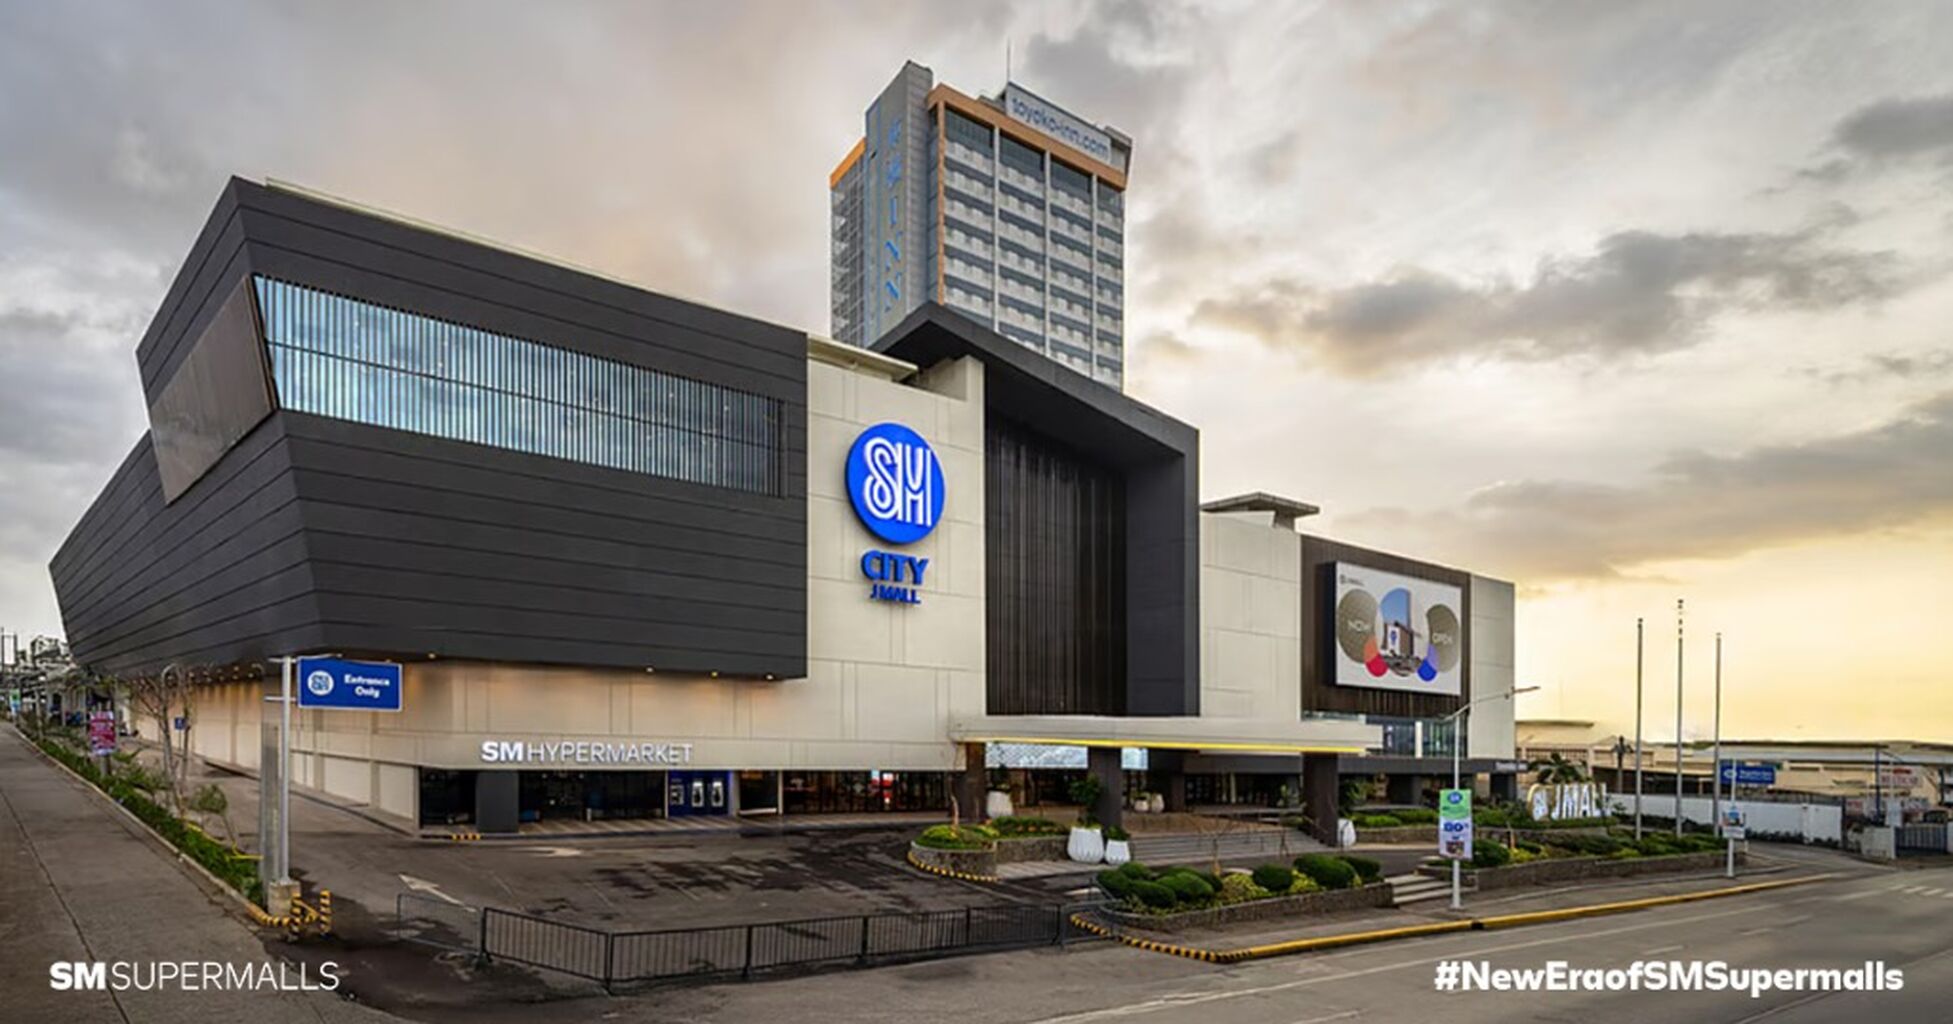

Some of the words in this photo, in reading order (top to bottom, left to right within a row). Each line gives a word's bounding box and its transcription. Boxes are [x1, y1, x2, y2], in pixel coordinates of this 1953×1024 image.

[1011, 97, 1108, 158] toyoko-inn.com
[863, 436, 932, 527] SM
[860, 550, 929, 585] CITY
[1347, 619, 1372, 632] NOW
[343, 673, 391, 687] Entrance
[355, 686, 380, 699] Only
[481, 741, 523, 763] SM
[526, 742, 693, 764] HYPERMARKET
